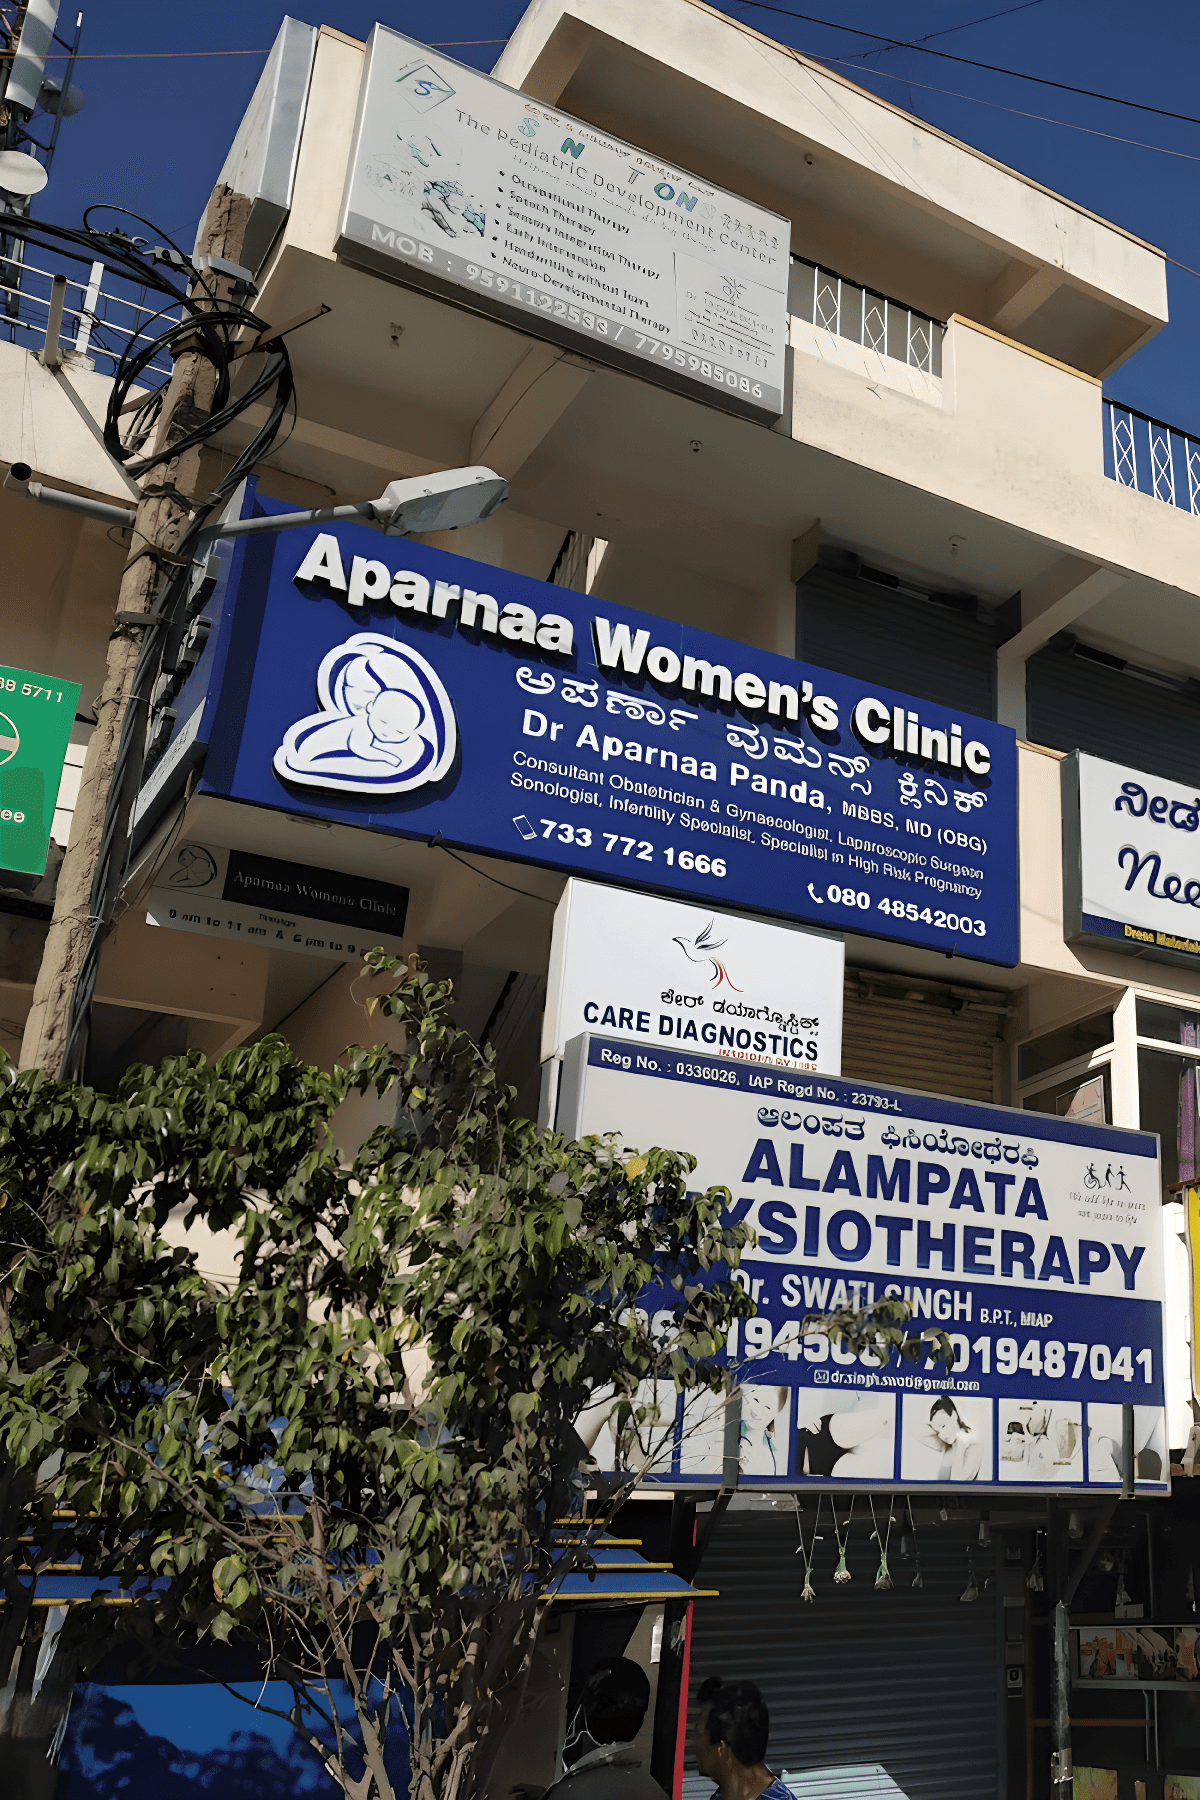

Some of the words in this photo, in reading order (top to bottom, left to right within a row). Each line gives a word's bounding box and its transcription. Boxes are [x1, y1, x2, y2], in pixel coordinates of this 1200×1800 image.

[371, 223, 434, 263] MOB
[293, 532, 574, 656] Aparnaa
[594, 615, 839, 731] Women's
[854, 696, 992, 775] Clinic
[512, 750, 604, 785] Consultant
[522, 708, 564, 742] Dr
[575, 723, 718, 782] Aparnaa
[730, 762, 832, 815] Panda,
[905, 818, 932, 838] MD
[937, 827, 988, 856] (OBG)
[539, 818, 593, 848] 733
[602, 832, 653, 862] 772
[663, 846, 727, 878] 1666
[848, 855, 879, 875] High
[826, 884, 871, 910] 080
[877, 898, 987, 937] 48542003
[583, 1001, 651, 1034] CARE
[658, 1014, 819, 1062] DIAGNOSTICS
[600, 1047, 632, 1070] Reg
[636, 1057, 662, 1073] No.
[777, 1080, 814, 1099] Regd
[742, 1137, 1049, 1222] ALAMPATA
[690, 1192, 1147, 1292] YSIOTHERAPY
[780, 1273, 875, 1315] SWATI
